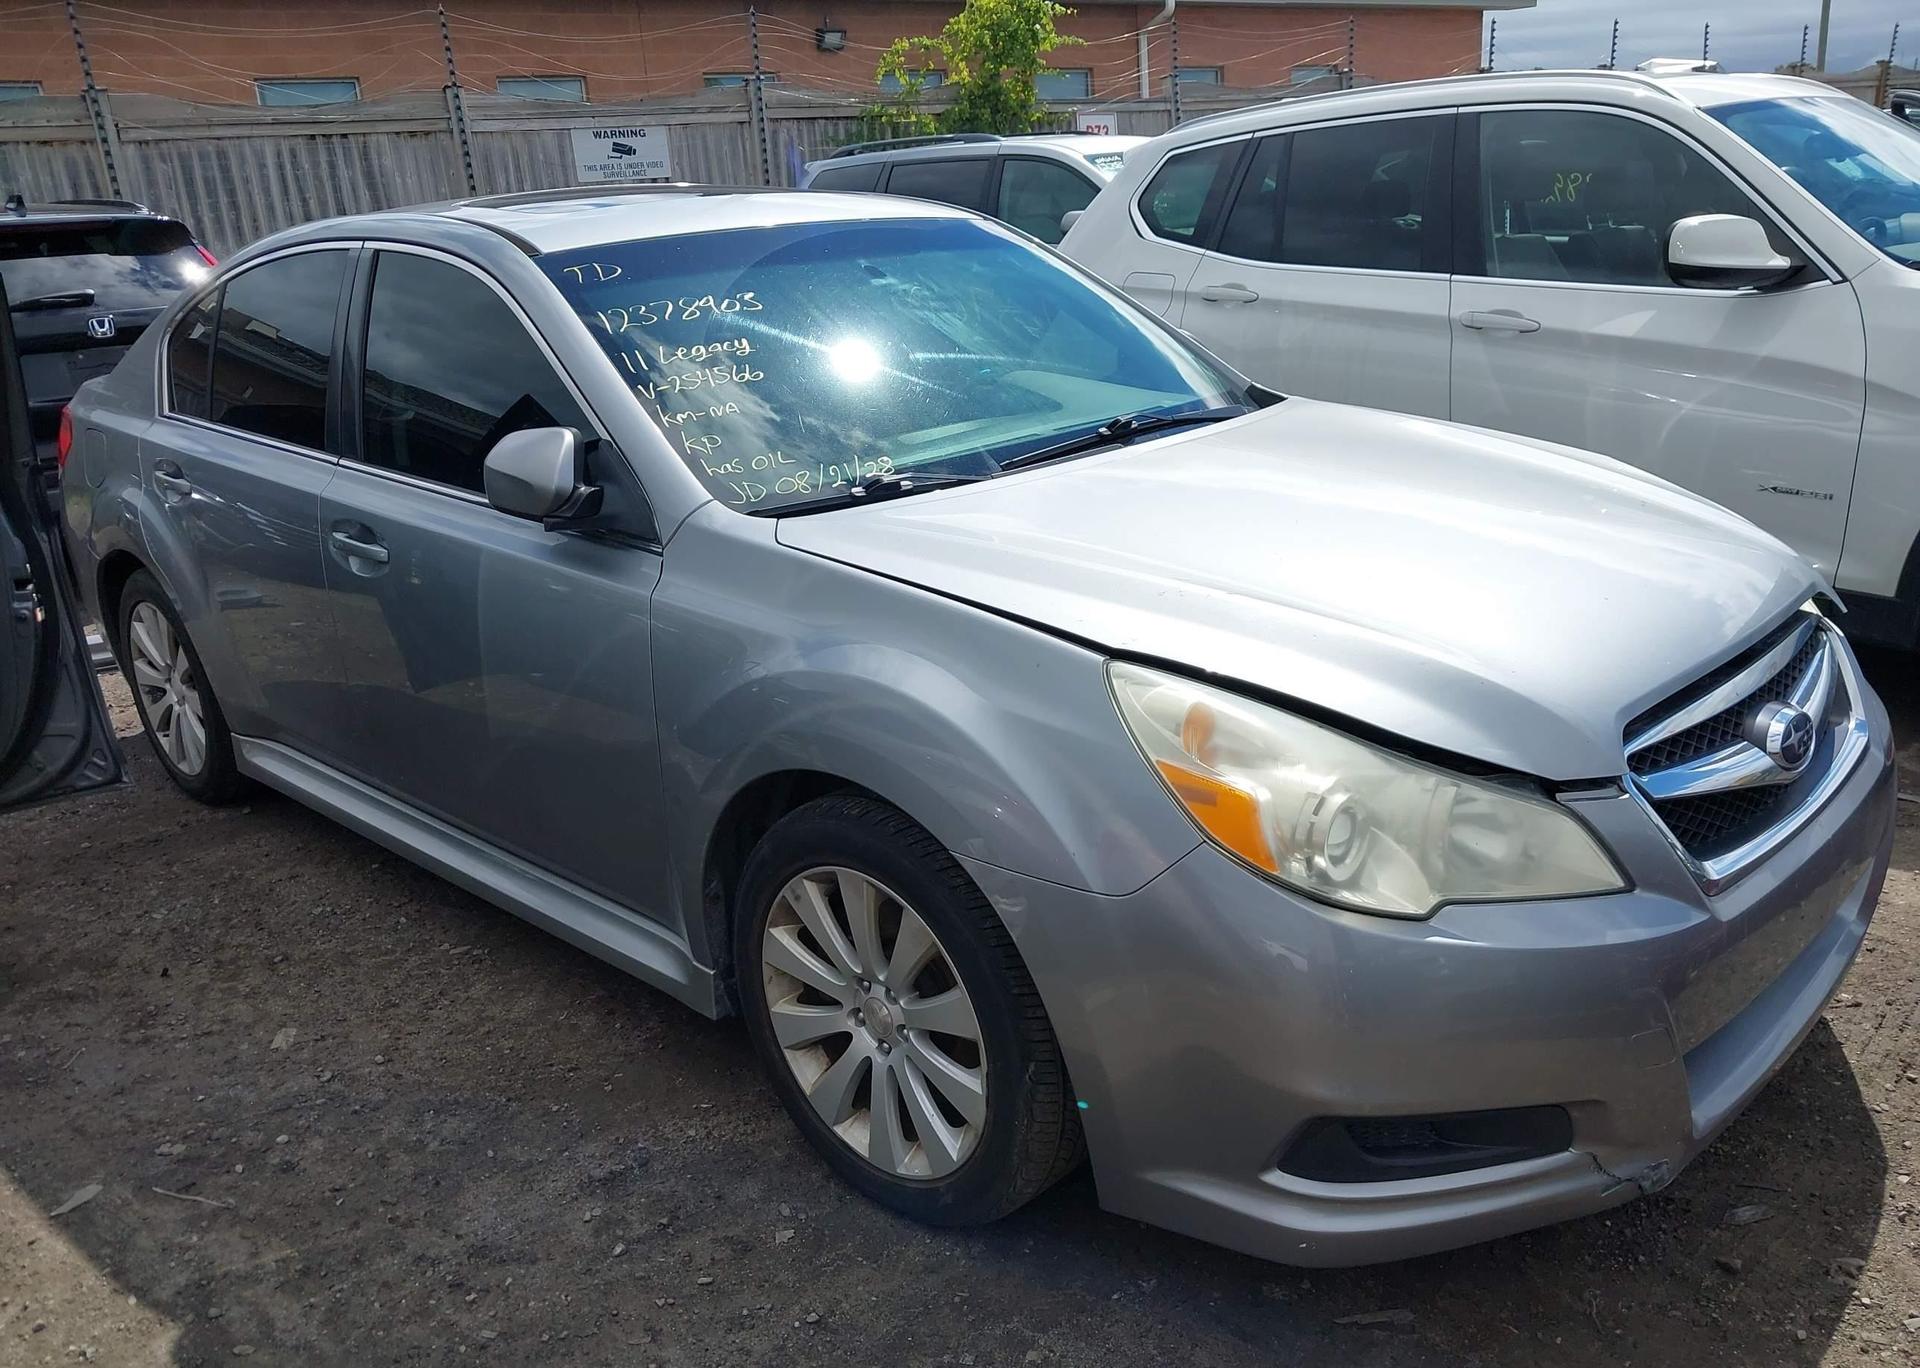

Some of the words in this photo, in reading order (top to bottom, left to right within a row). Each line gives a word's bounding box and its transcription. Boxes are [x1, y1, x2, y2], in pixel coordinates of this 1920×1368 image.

[592, 129, 646, 139] WARNING
[584, 164, 598, 172] THIS
[600, 163, 615, 171] AREA
[624, 162, 645, 170] UNDER
[646, 160, 664, 168] VIDEO
[603, 170, 648, 178] SURVEILLANCE
[596, 291, 764, 335] 12378903
[621, 349, 649, 374] 11
[659, 337, 757, 364] Legacy
[700, 458, 744, 477] has
[751, 451, 797, 471] OIL
[728, 482, 767, 505] JD
